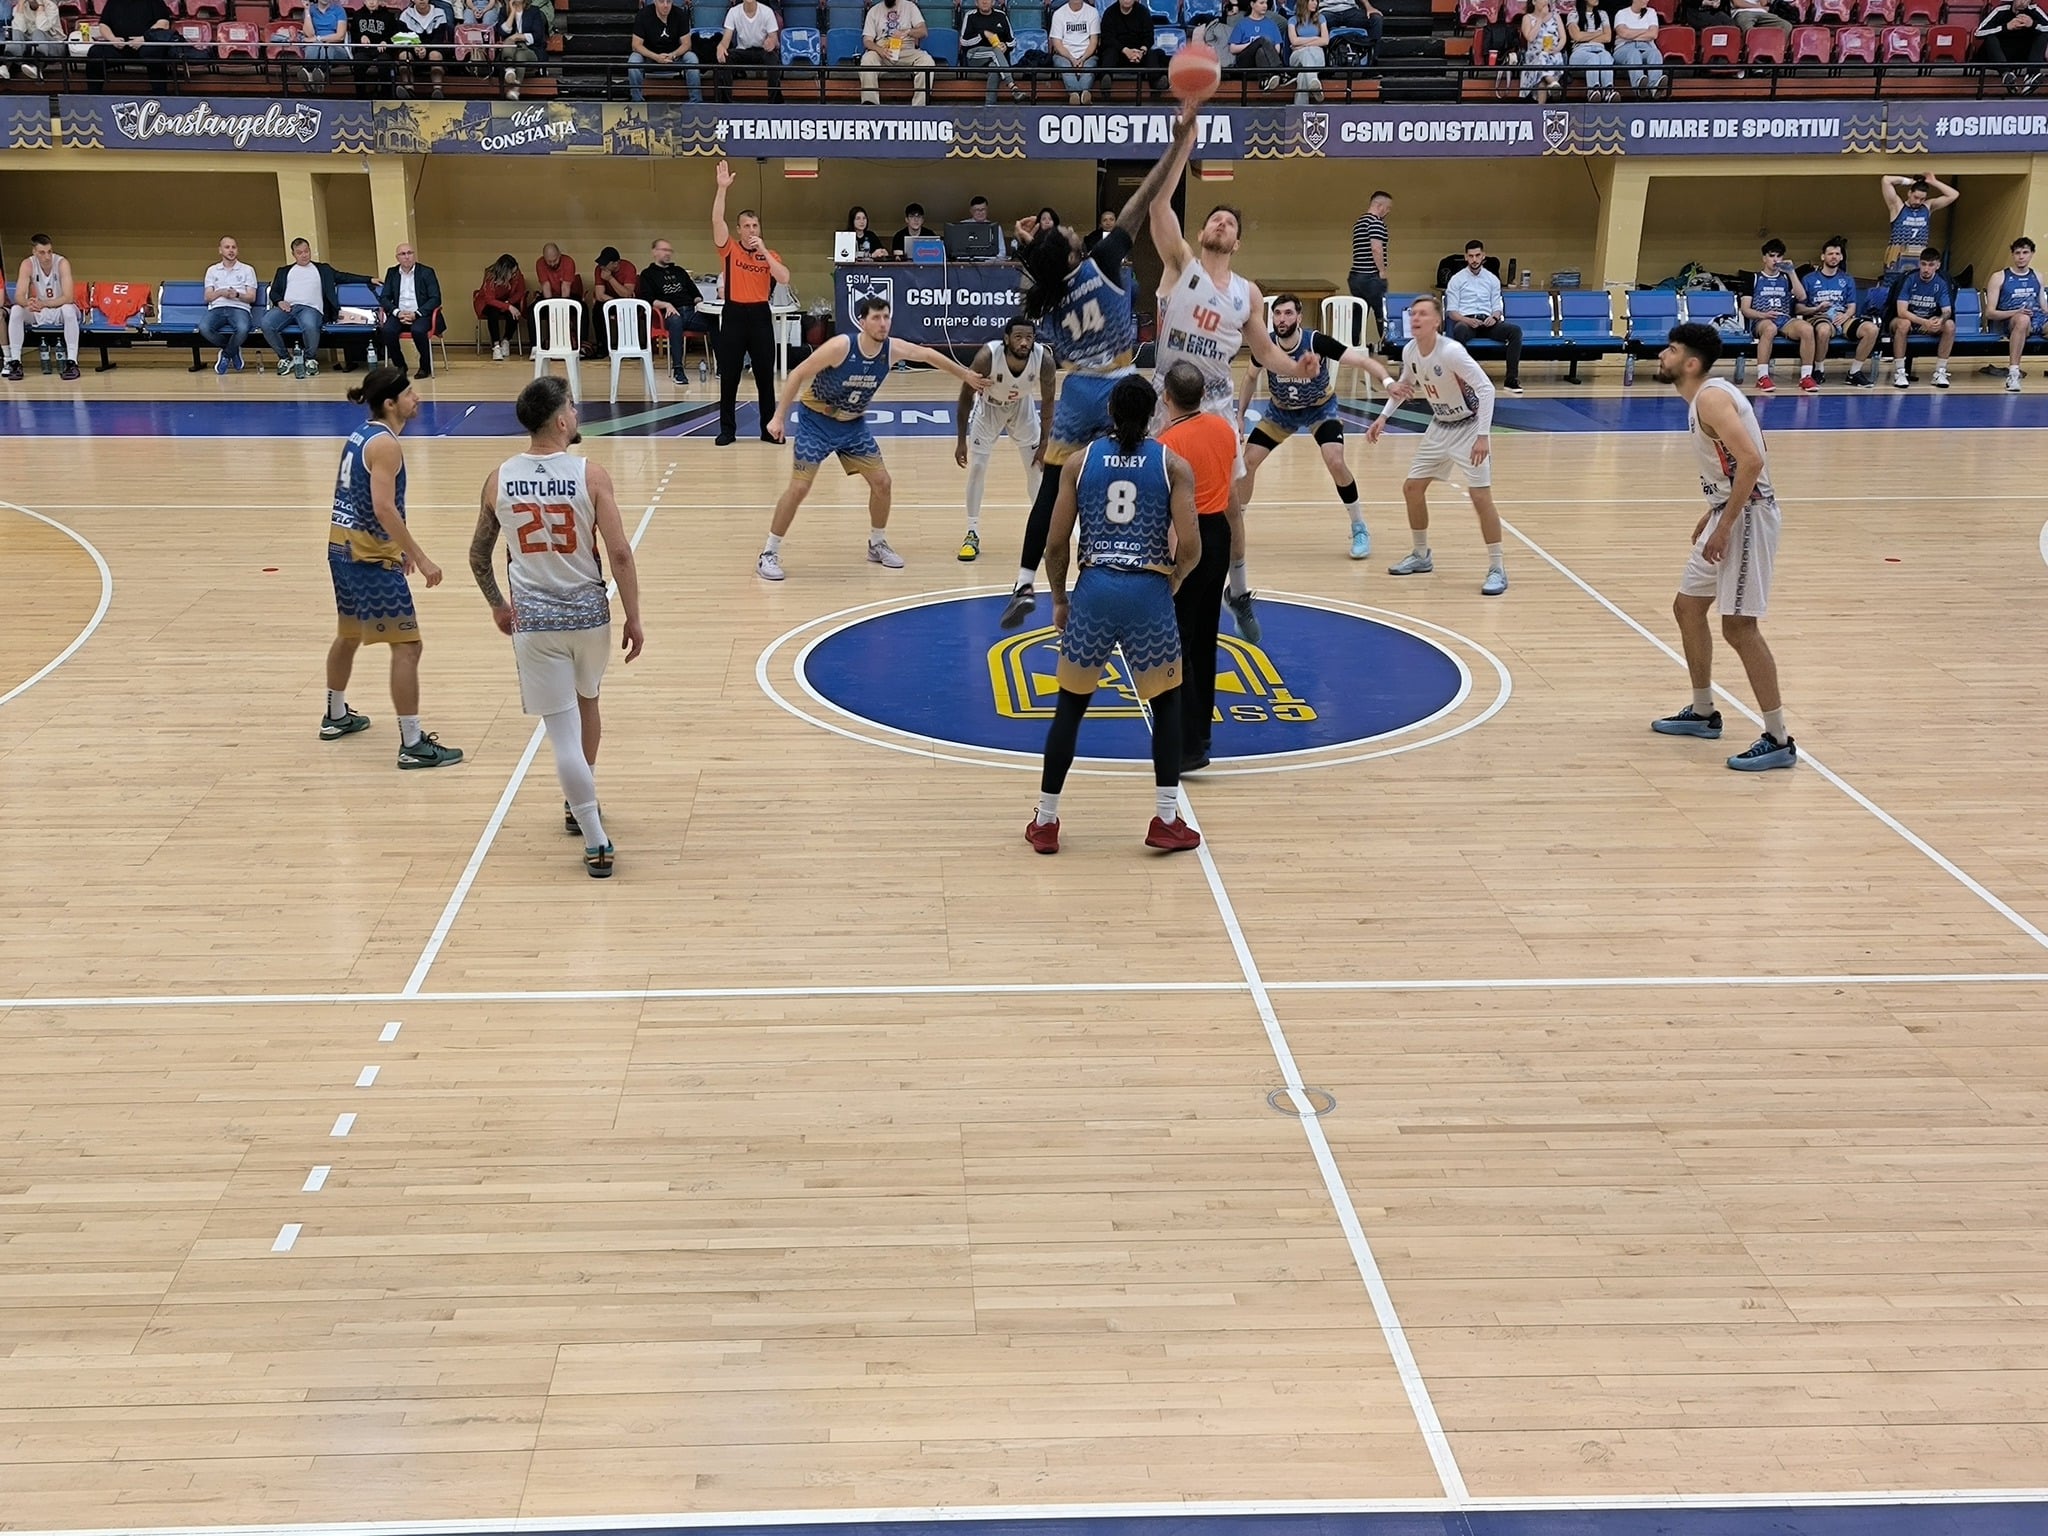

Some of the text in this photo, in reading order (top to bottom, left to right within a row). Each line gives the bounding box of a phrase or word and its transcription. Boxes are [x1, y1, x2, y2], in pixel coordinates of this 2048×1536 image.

[1066, 23, 1087, 32] PUMA
[137, 99, 300, 148] Constangeles
[511, 105, 545, 128] Visit
[715, 119, 954, 142] #TEAMISEVERYTHING
[1341, 120, 1534, 145] CSM CONSTANȚA
[1630, 118, 1840, 138] O MARE DE SPORTIVI
[1936, 115, 2048, 137] #OSINGUR
[1911, 228, 1920, 239] 7
[846, 275, 869, 284] CSM
[906, 289, 1021, 306] CSM Consta
[1768, 298, 1782, 308] 13
[923, 317, 931, 326] o
[934, 317, 969, 326] mare
[972, 314, 987, 326] de
[1061, 297, 1106, 341] 14
[1192, 304, 1221, 332] 40
[1189, 333, 1218, 350] CSM
[1186, 342, 1228, 361] GALAT
[848, 391, 861, 404] 6
[1008, 390, 1019, 400] 2
[1287, 386, 1299, 400] 2
[1424, 383, 1440, 399] 14
[340, 450, 354, 489] 4
[1103, 455, 1147, 468] TONEY
[1105, 480, 1137, 525] 8
[511, 502, 577, 554] 23
[1211, 704, 1318, 722] CS
